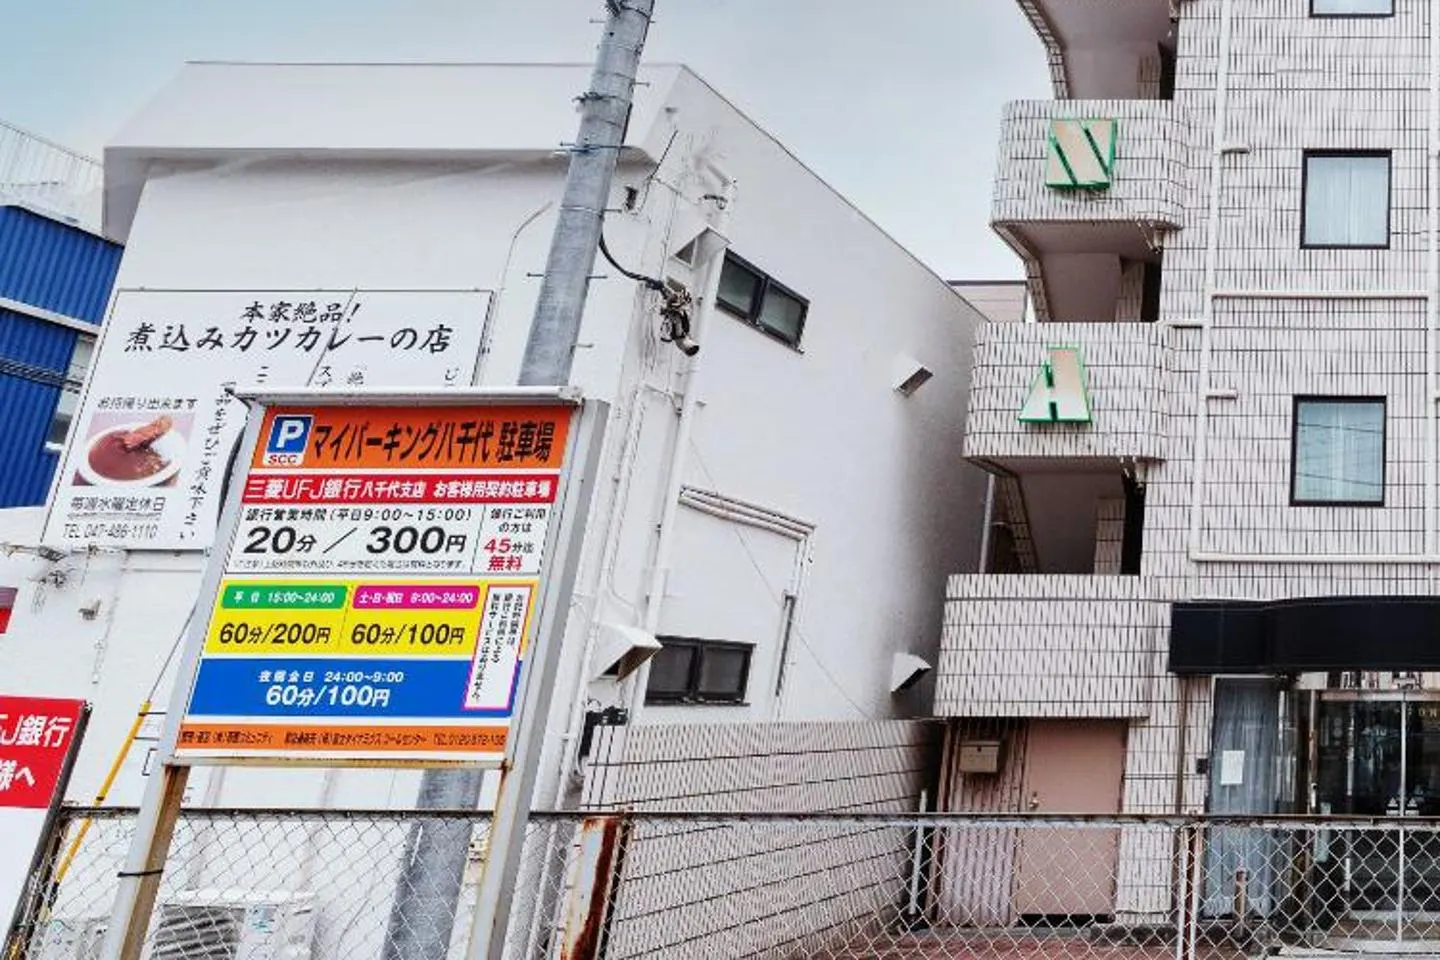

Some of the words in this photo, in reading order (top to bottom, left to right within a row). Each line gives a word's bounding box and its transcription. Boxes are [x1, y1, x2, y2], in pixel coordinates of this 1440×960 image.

[125, 324, 454, 353] 煮込みカツカレーの店
[496, 420, 556, 463] 駐車場
[498, 522, 532, 534] の方は
[487, 555, 523, 571] 無料
